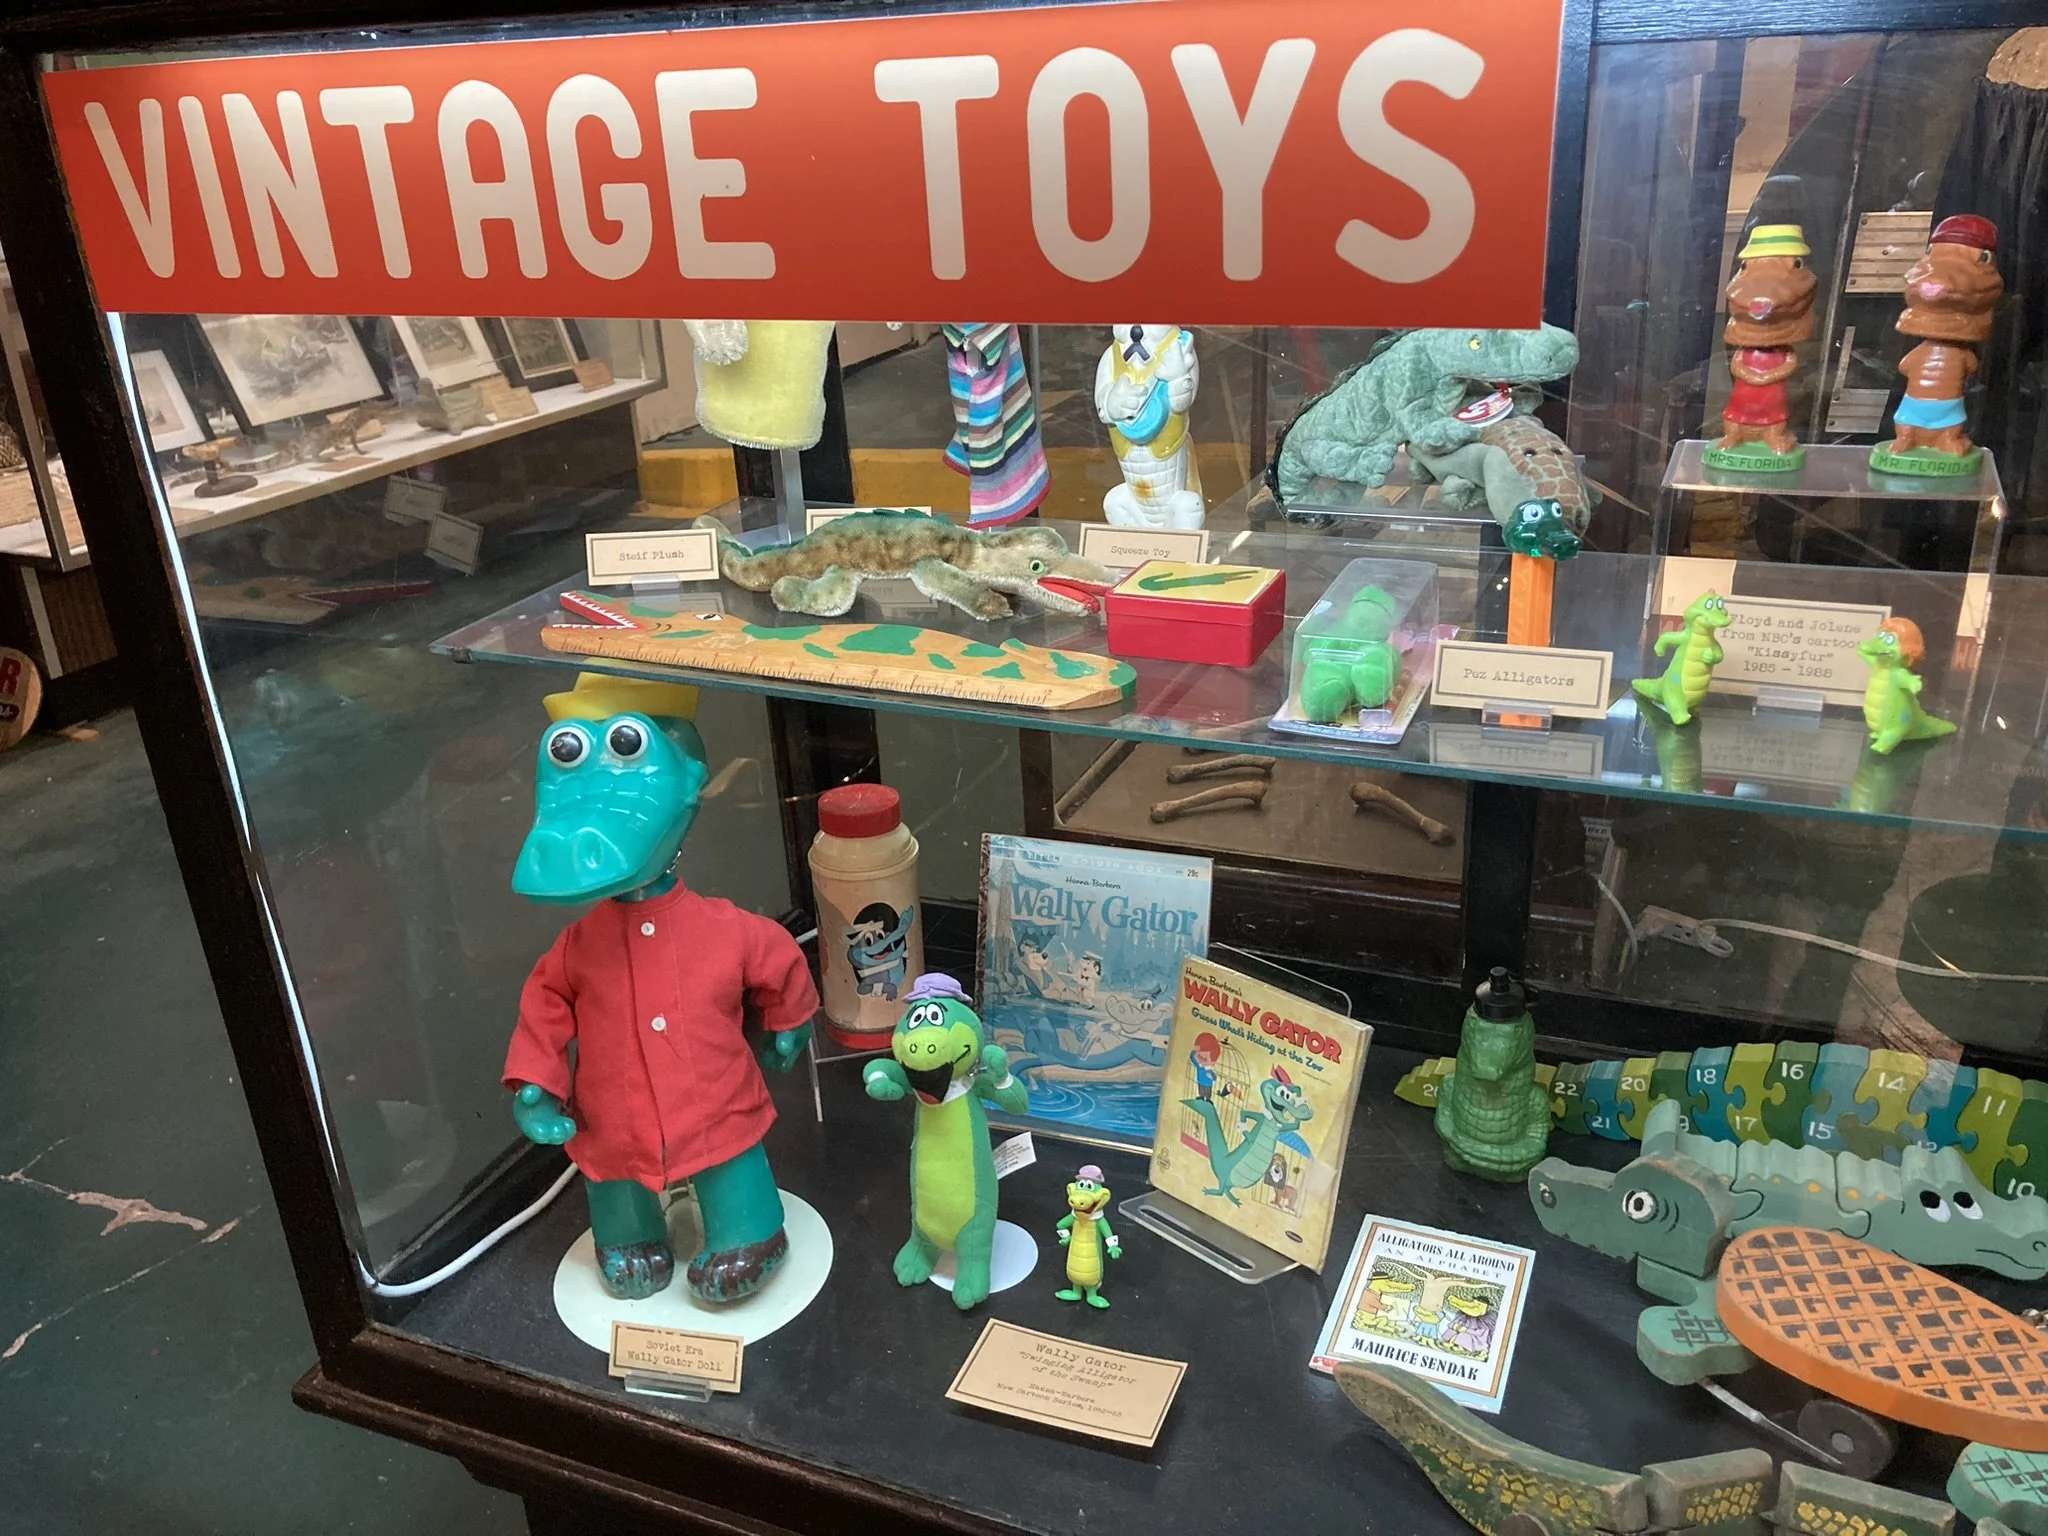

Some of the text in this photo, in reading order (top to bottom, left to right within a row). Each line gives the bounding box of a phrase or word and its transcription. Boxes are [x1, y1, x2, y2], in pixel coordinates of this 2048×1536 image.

[84, 28, 1485, 284] VINTAGE TOYS
[1740, 457, 1792, 471] FLORIDA
[1909, 459, 1970, 474] FLORIDA
[652, 550, 684, 560] Plush
[1111, 545, 1170, 558] Squeeze Toy
[1729, 613, 1861, 634] Floyd and Jolene
[1720, 628, 1860, 649] from NBC's cartoo
[1747, 645, 1834, 663] "Kissyfur"
[1743, 660, 1776, 673] 1985
[1463, 668, 1574, 687] Pez Alligators
[1010, 882, 1199, 936] Wally Gator
[1184, 976, 1342, 1065] WALLY GATOR
[1191, 1007, 1218, 1026] Guess
[1246, 1030, 1276, 1056] Hiding
[1277, 1047, 1287, 1057] at
[1288, 1049, 1304, 1064] the
[1305, 1056, 1324, 1072] Zoo
[1696, 1068, 1717, 1085] 18
[1780, 1060, 1804, 1080] 16
[1554, 1081, 1580, 1097] 22
[1621, 1076, 1647, 1092] 20
[1877, 1071, 1908, 1093] 14
[1983, 1095, 2006, 1117] 11
[1591, 1115, 1610, 1129] 21
[1735, 1115, 1757, 1131] 17
[1807, 1118, 1835, 1140] 15
[2007, 1178, 2036, 1199] 10
[1377, 1233, 1515, 1272] ALLIGATORS ALL AROUND
[1416, 1254, 1502, 1279] ALPHABET
[646, 1340, 704, 1356] Soviet Era
[1036, 1343, 1127, 1372] Wally Gator
[627, 1350, 722, 1372] Wally Gator Doll
[1351, 1337, 1419, 1366] MAURICE
[1419, 1355, 1479, 1381] SENDAK
[1032, 1365, 1048, 1373] of
[1050, 1369, 1068, 1379] the
[1077, 1367, 1137, 1384] Alligator
[1016, 1387, 1050, 1401] Cartoon
